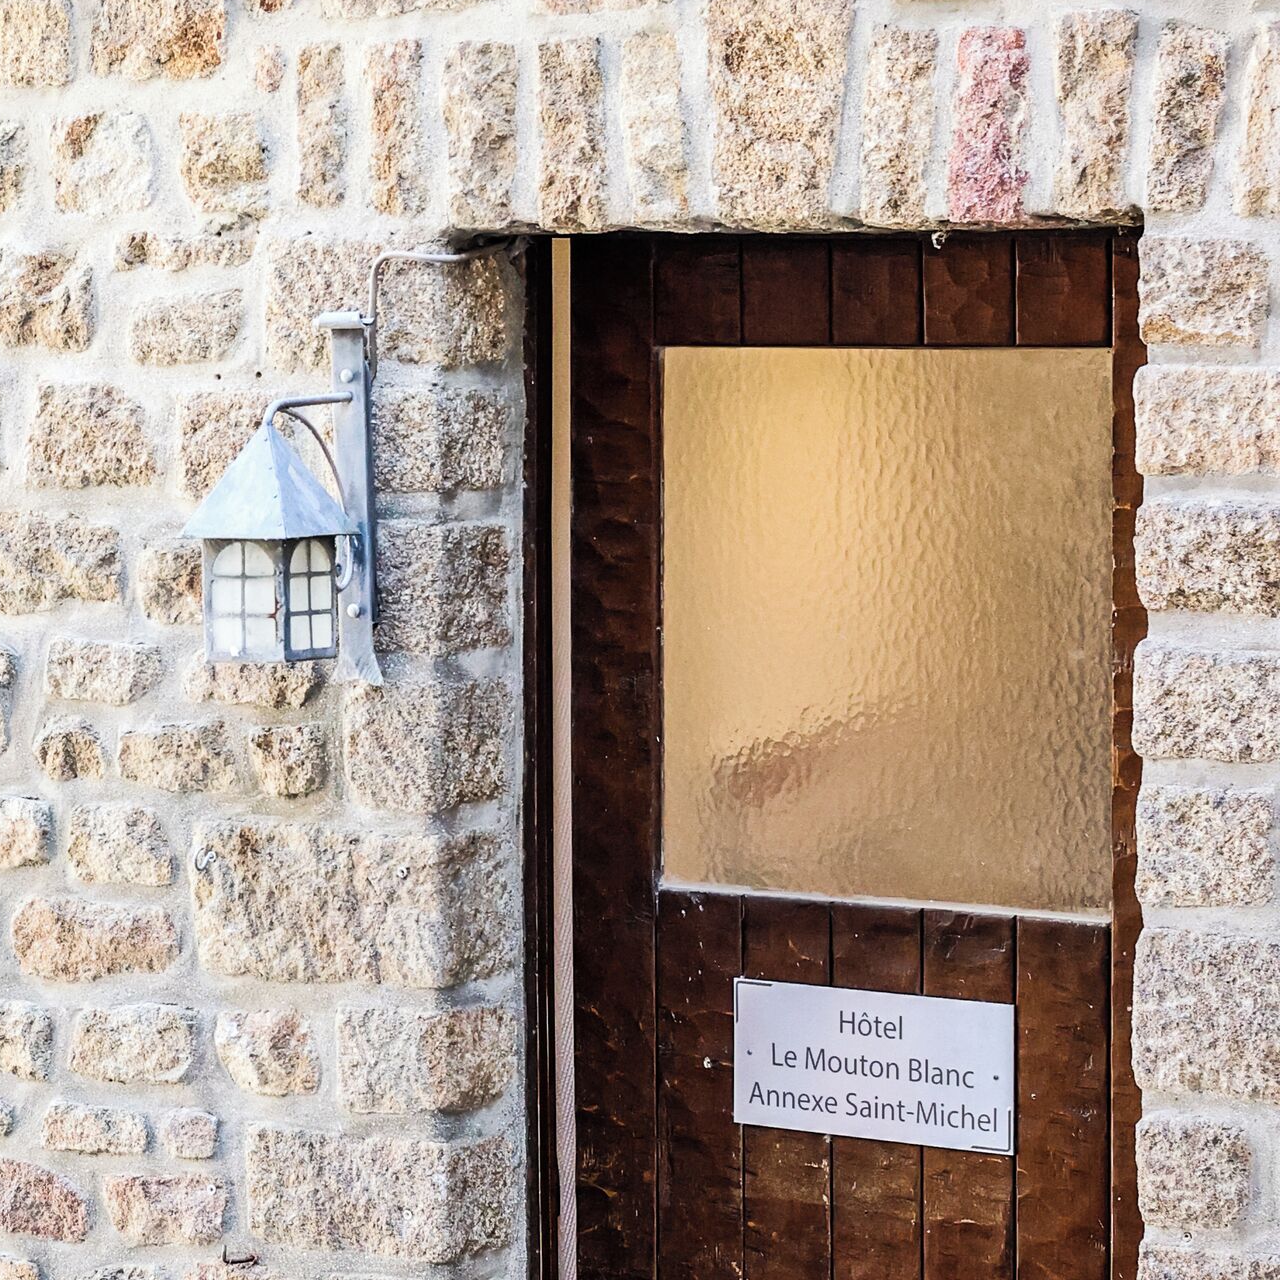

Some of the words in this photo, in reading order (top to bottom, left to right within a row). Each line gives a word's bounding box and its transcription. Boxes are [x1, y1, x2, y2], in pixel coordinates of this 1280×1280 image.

[839, 1010, 903, 1040] Hôtel
[771, 1042, 797, 1069] Le
[805, 1047, 899, 1080] Mouton
[908, 1058, 975, 1089] Blanc
[748, 1082, 838, 1114] Annexe
[845, 1093, 998, 1132] Saint-Michel
